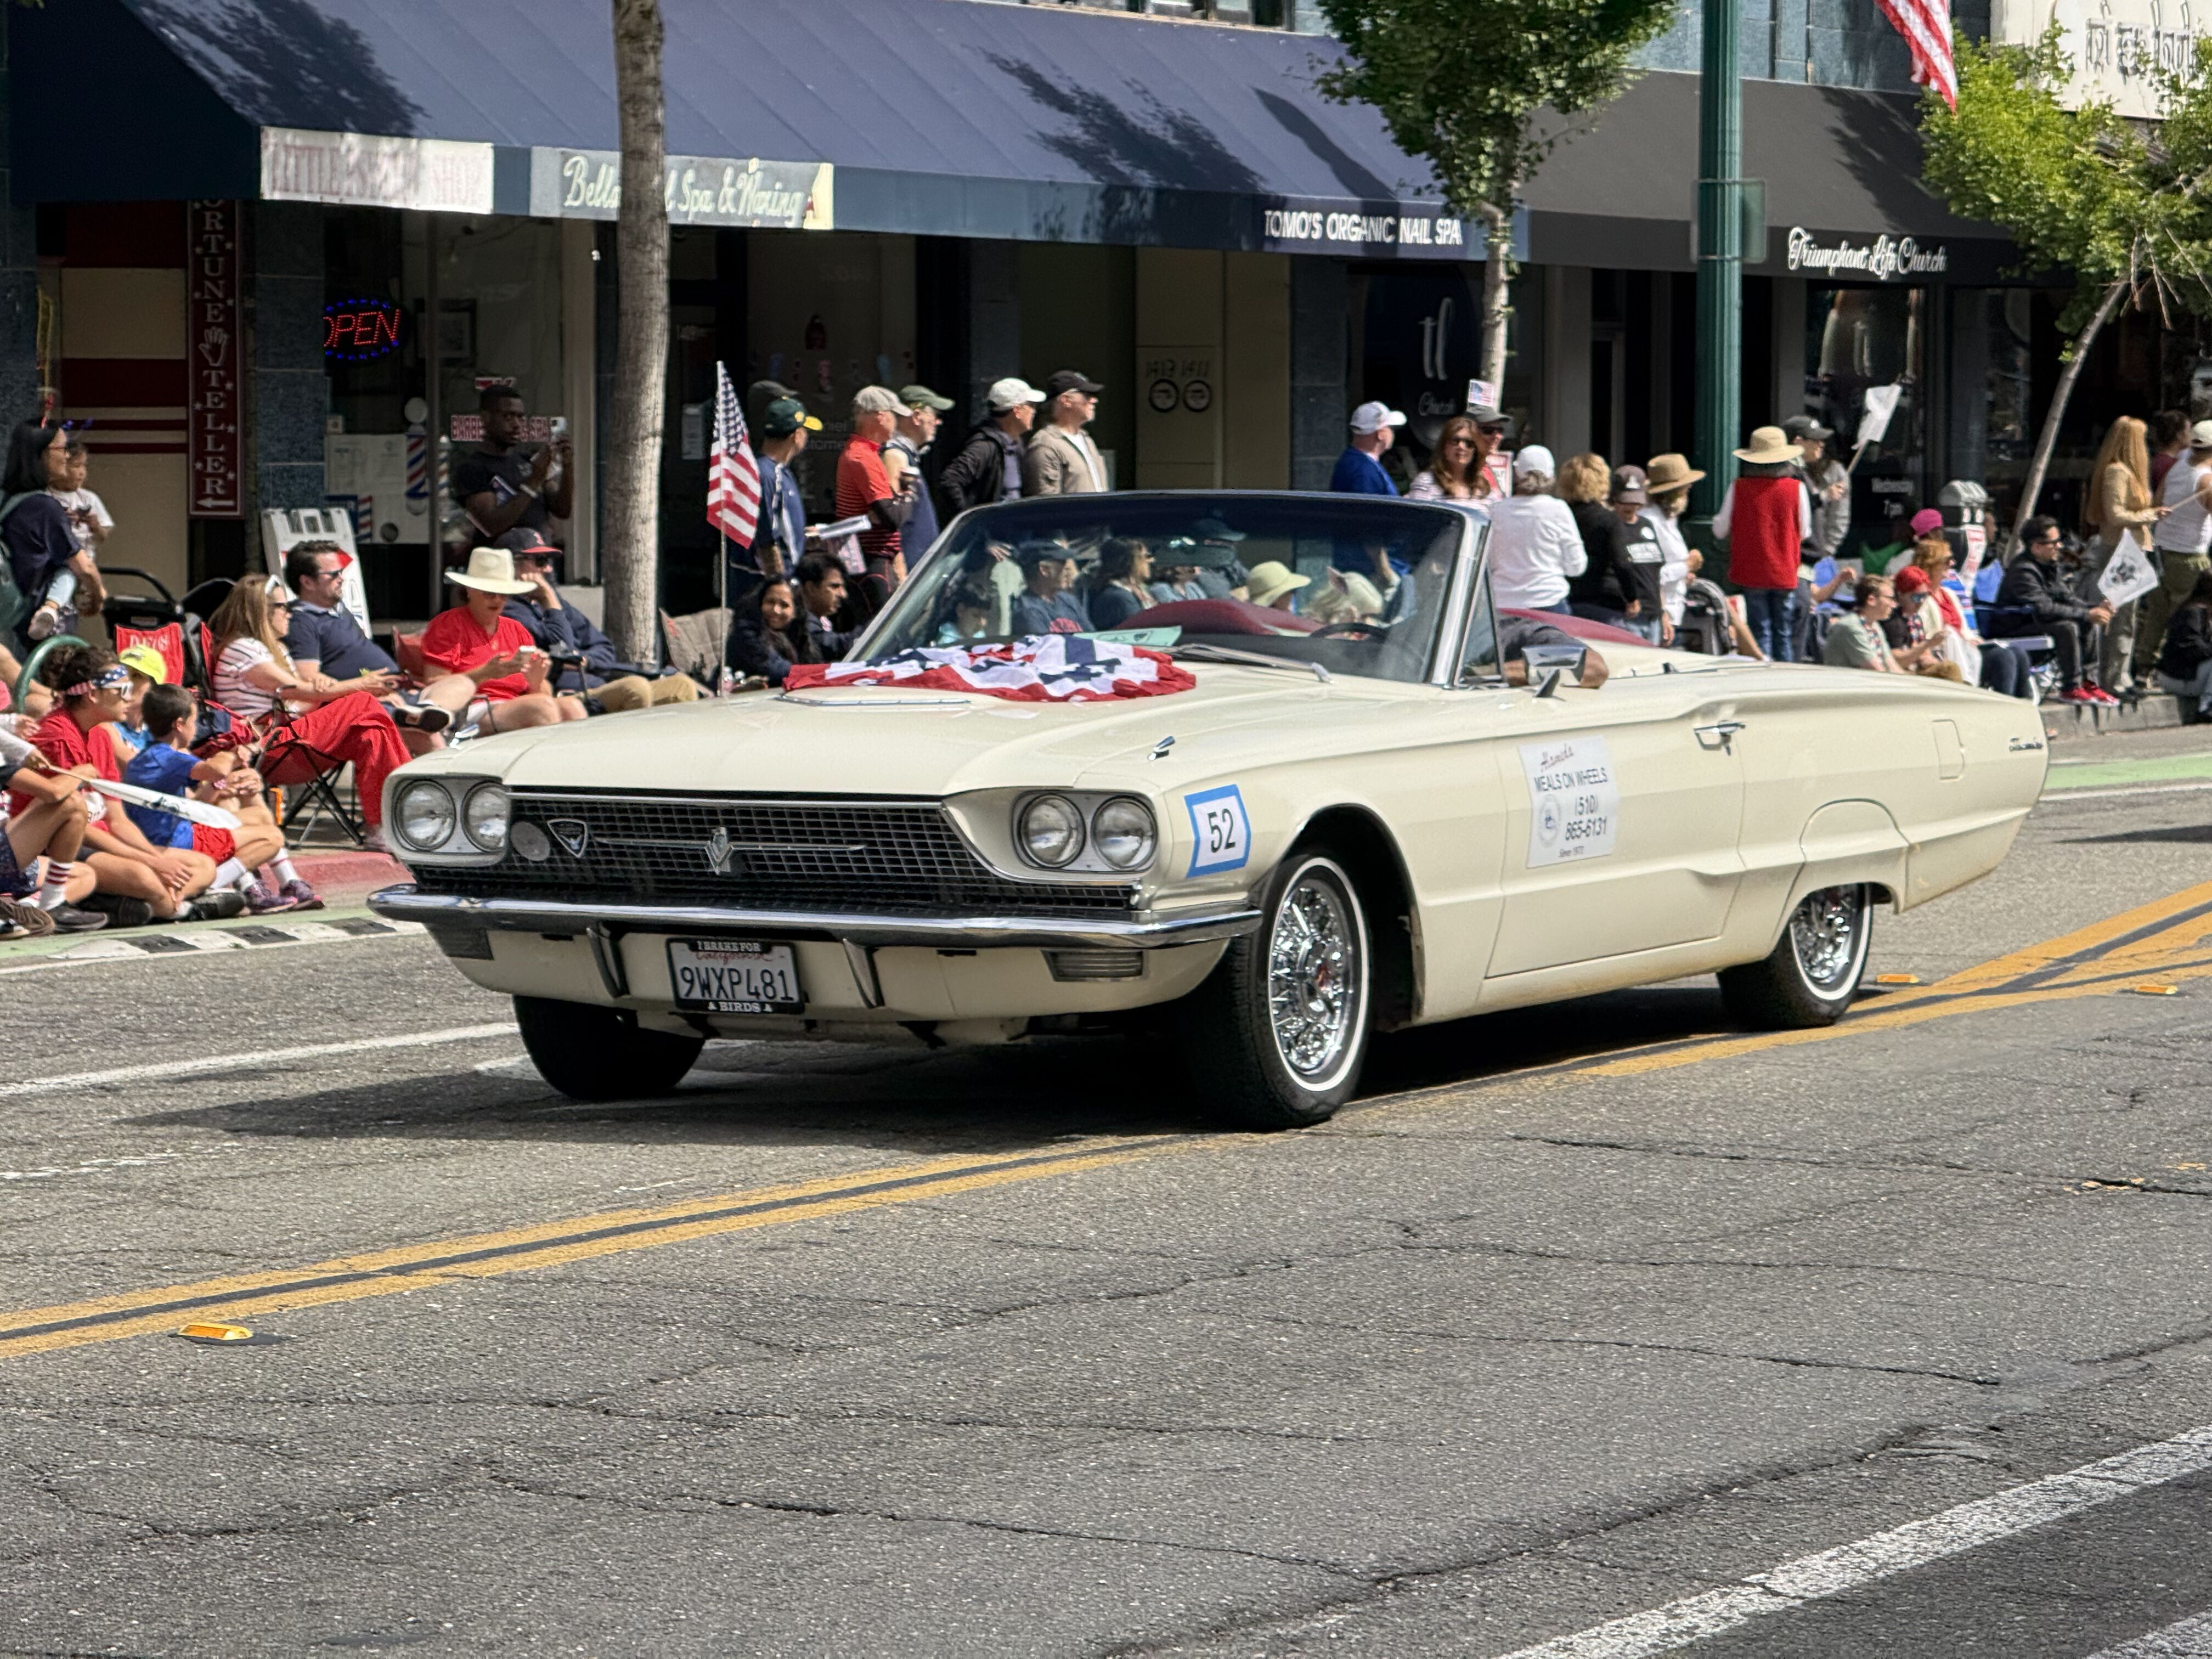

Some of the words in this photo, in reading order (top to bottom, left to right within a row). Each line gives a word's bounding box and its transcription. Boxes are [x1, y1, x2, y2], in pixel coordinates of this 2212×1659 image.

[677, 168, 715, 220] Spa
[1265, 210, 1323, 240] TOMO'S
[1325, 212, 1395, 243] ORGANIC
[1399, 218, 1432, 244] NAIL
[1435, 218, 1463, 246] SPA
[1897, 236, 1948, 274] Church
[202, 370, 227, 495] TELLER
[1534, 774, 1562, 792] MEALS
[1562, 771, 1576, 788] ON
[1575, 767, 1608, 787] WHEELS
[1575, 794, 1599, 816] (510)
[1207, 808, 1237, 853] 52
[740, 942, 761, 952] FOR
[680, 966, 794, 1001] 9WXP481
[719, 1001, 761, 1012] BIRDS
